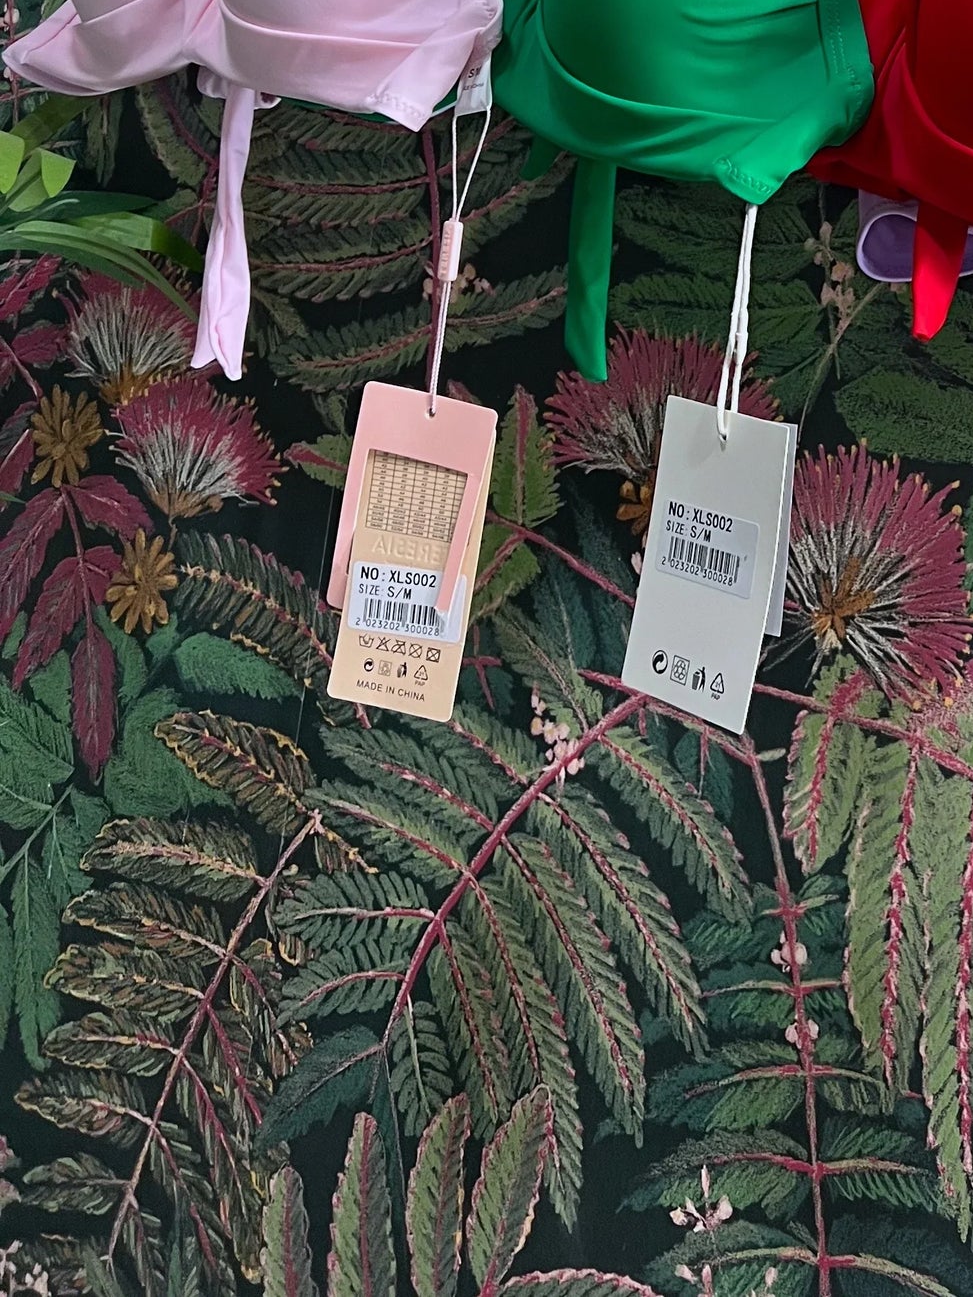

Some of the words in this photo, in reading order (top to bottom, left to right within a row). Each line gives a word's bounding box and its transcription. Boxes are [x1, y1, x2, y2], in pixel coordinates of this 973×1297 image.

[691, 508, 734, 532] XLS002
[689, 526, 713, 543] S/M
[388, 570, 437, 588] XLS002
[387, 586, 412, 600] S/M
[356, 679, 383, 692] MADE
[385, 685, 396, 695] IN
[397, 688, 426, 702] CHINA
